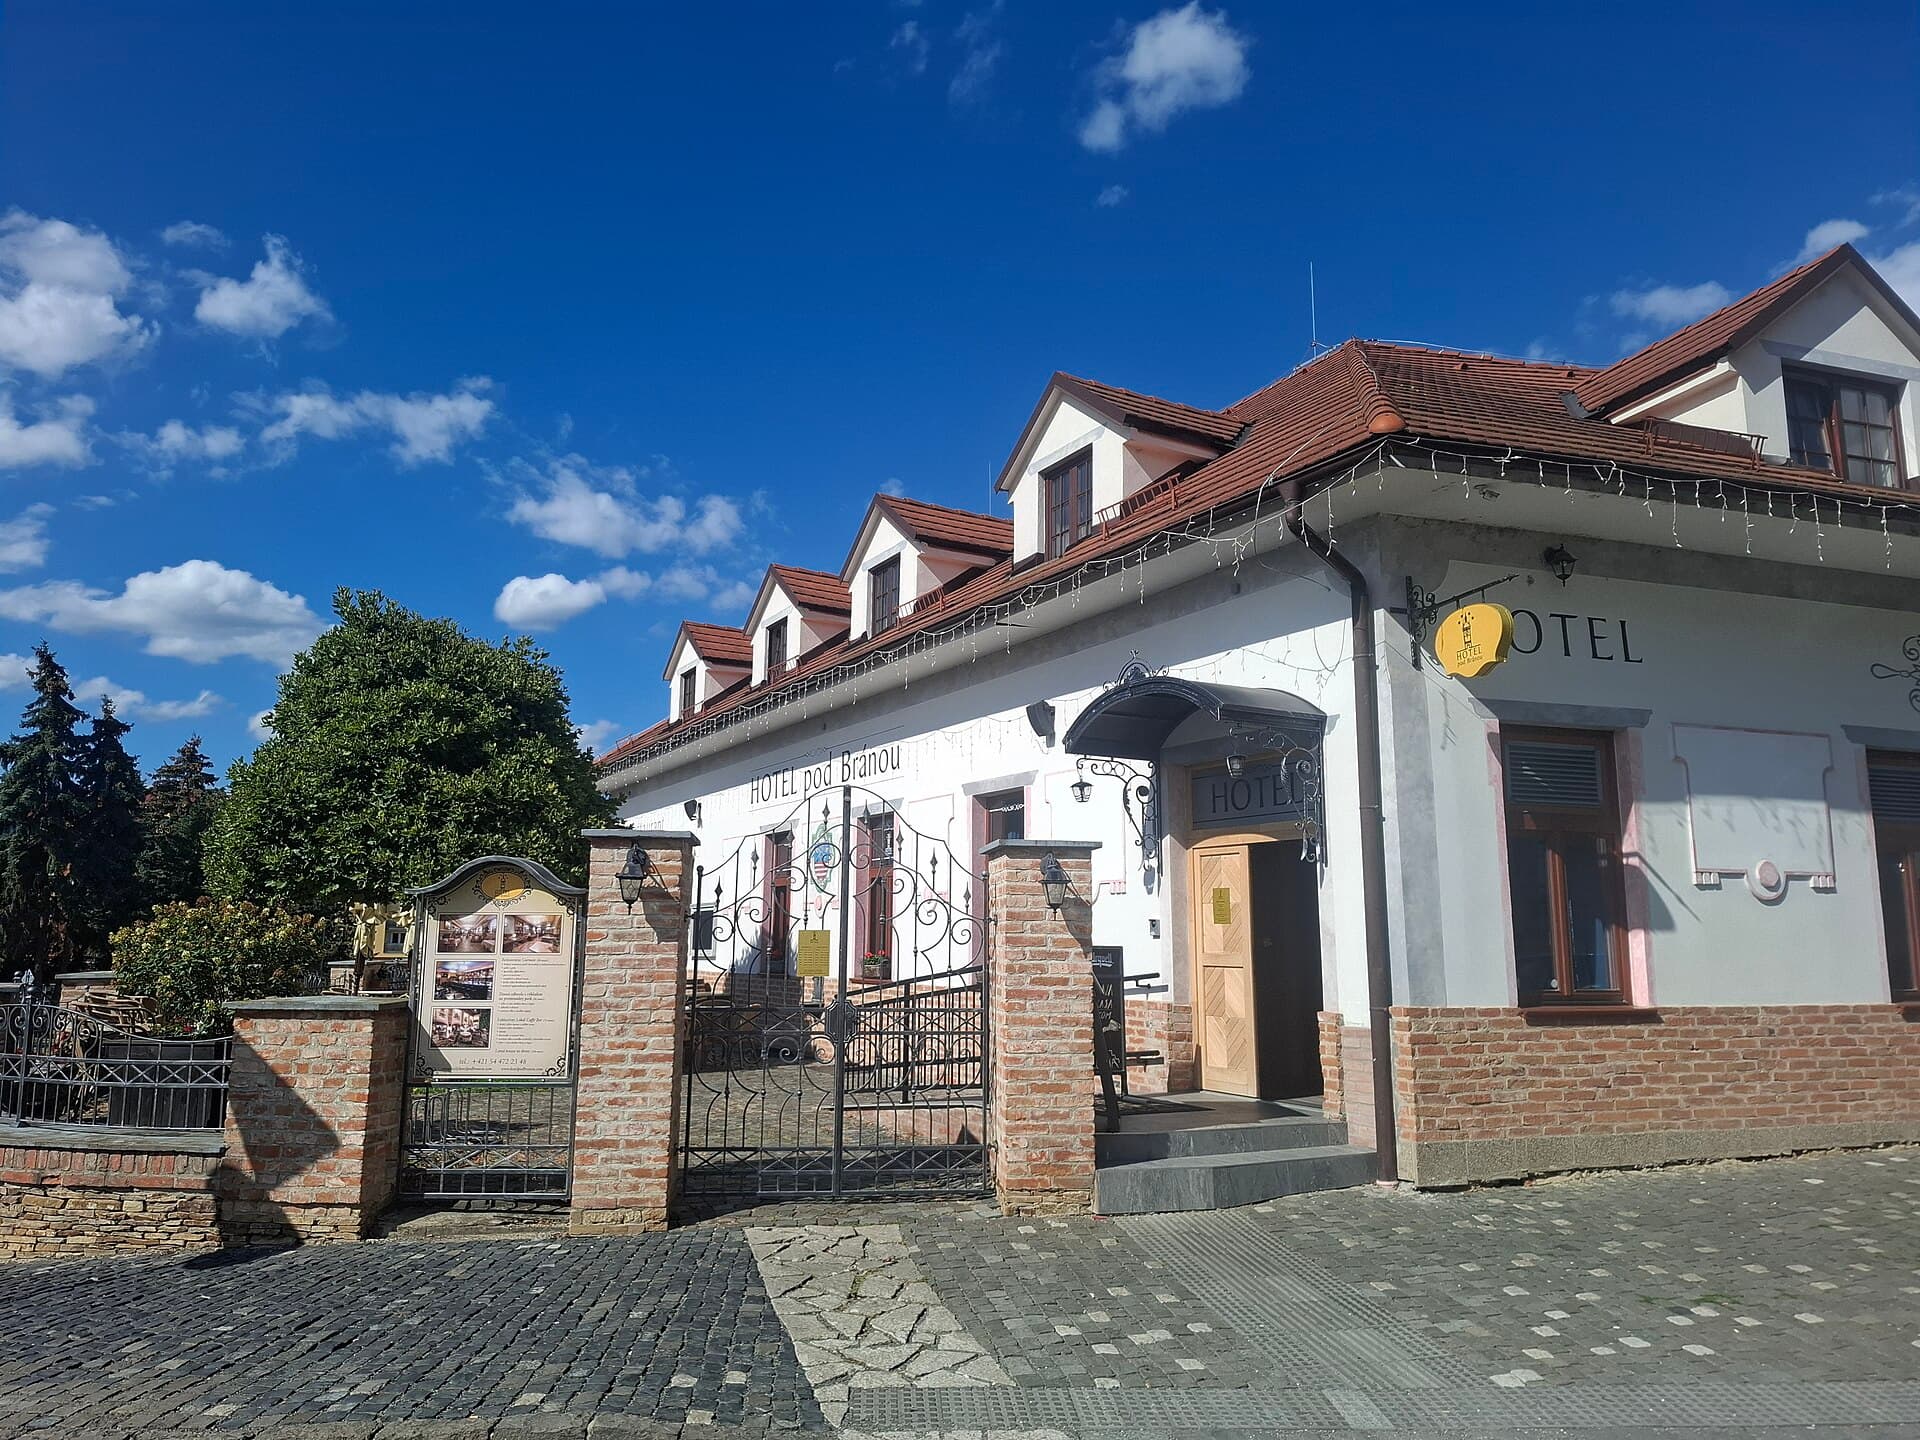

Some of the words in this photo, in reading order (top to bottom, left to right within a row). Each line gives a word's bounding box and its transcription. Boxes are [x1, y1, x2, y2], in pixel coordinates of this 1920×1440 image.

[1456, 646, 1482, 661] HOTEL
[1511, 608, 1644, 664] OTEL
[750, 766, 798, 805] HOTEL
[804, 751, 833, 800] pod
[841, 744, 901, 783] Bránou
[1211, 772, 1302, 814] HOTEL
